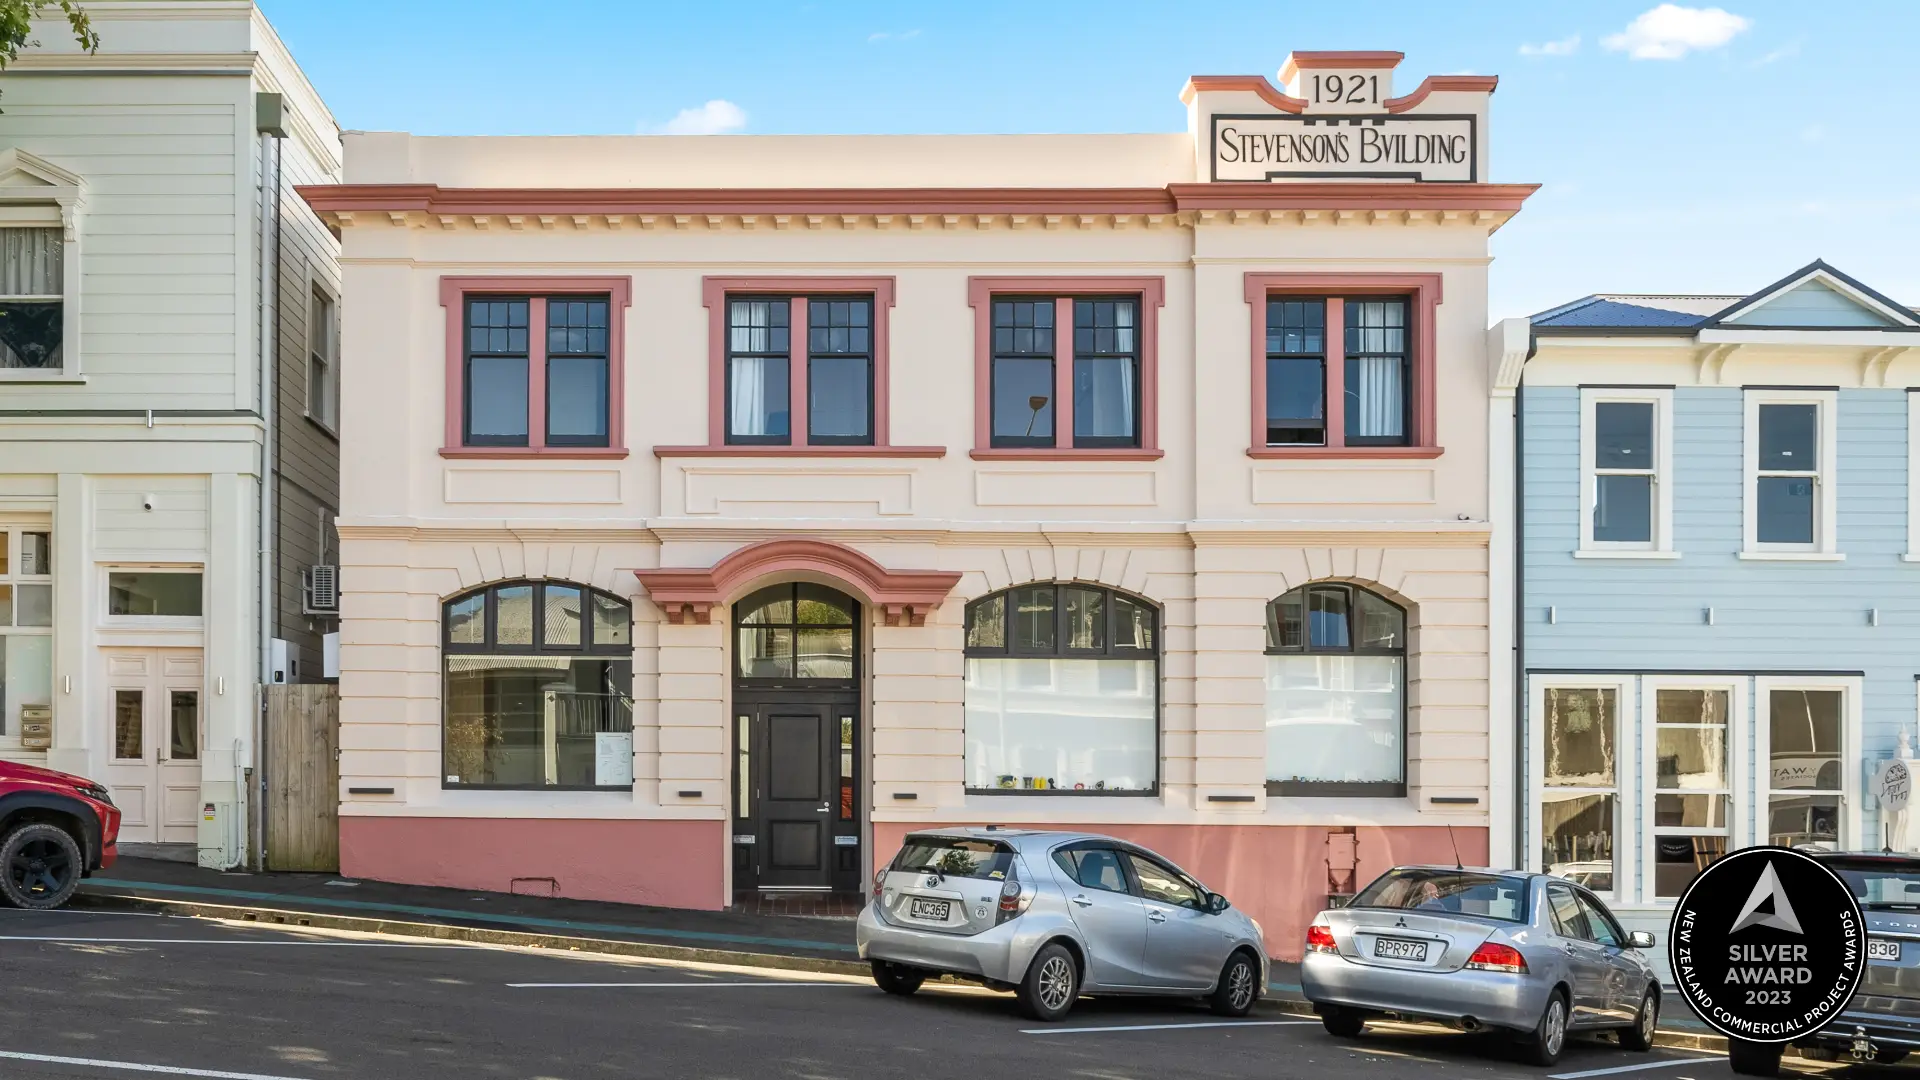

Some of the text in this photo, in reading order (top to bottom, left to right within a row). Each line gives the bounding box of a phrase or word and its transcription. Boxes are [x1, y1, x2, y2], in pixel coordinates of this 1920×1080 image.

[1312, 74, 1378, 104] 1921
[912, 899, 948, 917] LNC365
[1376, 940, 1425, 958] BPR972
[1869, 943, 1898, 956] 830
